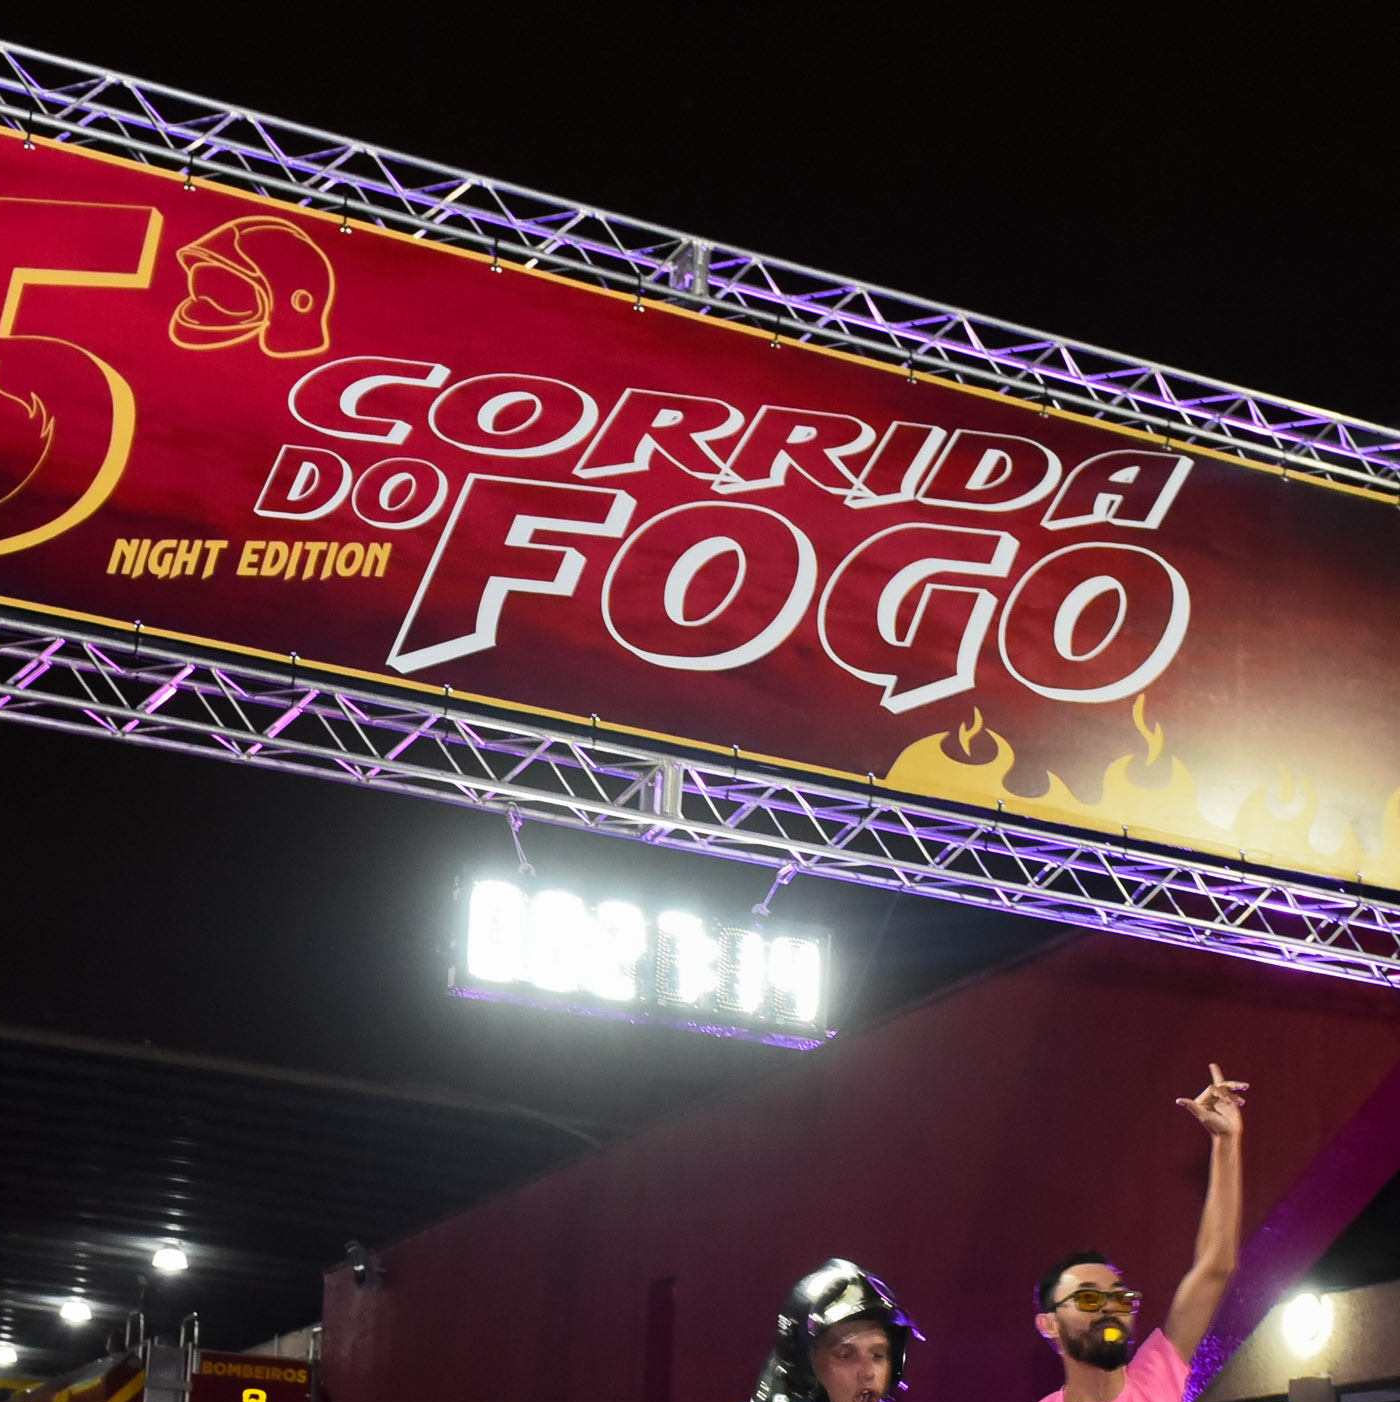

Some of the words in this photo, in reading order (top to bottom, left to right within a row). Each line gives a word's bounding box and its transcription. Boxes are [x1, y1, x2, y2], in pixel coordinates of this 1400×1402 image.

[287, 356, 1194, 531] CORRIDA
[254, 444, 449, 530] DO
[106, 537, 229, 580] NIGHT
[236, 539, 392, 581] EDITION
[386, 473, 1191, 714] FOGO
[201, 1360, 308, 1384] BOMBEIROS
